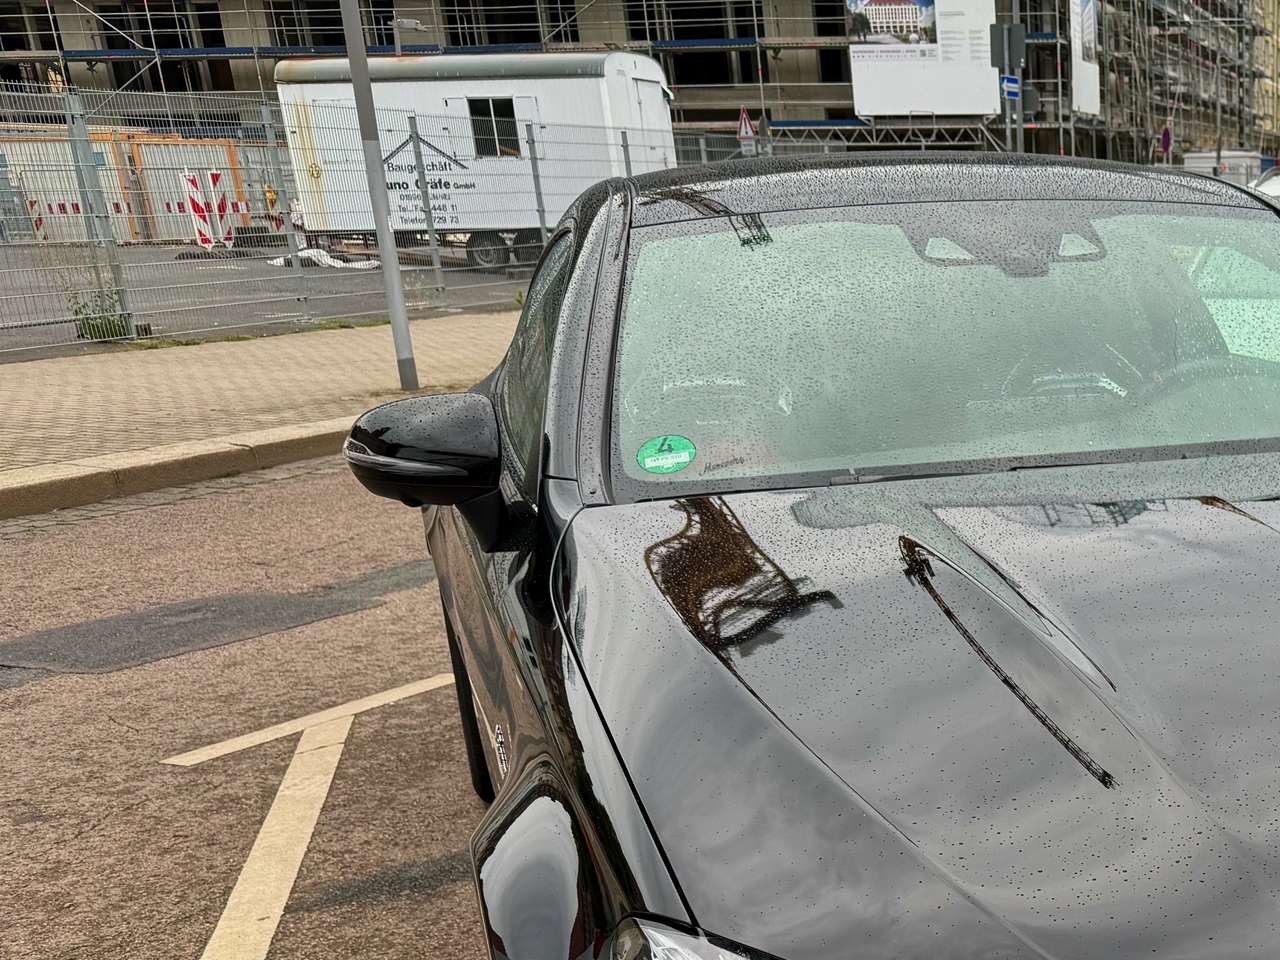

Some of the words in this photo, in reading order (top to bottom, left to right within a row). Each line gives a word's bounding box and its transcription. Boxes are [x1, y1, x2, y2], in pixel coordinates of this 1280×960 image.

[387, 161, 452, 174] Baugechäft
[386, 181, 409, 190] uno
[657, 437, 674, 453] 4
